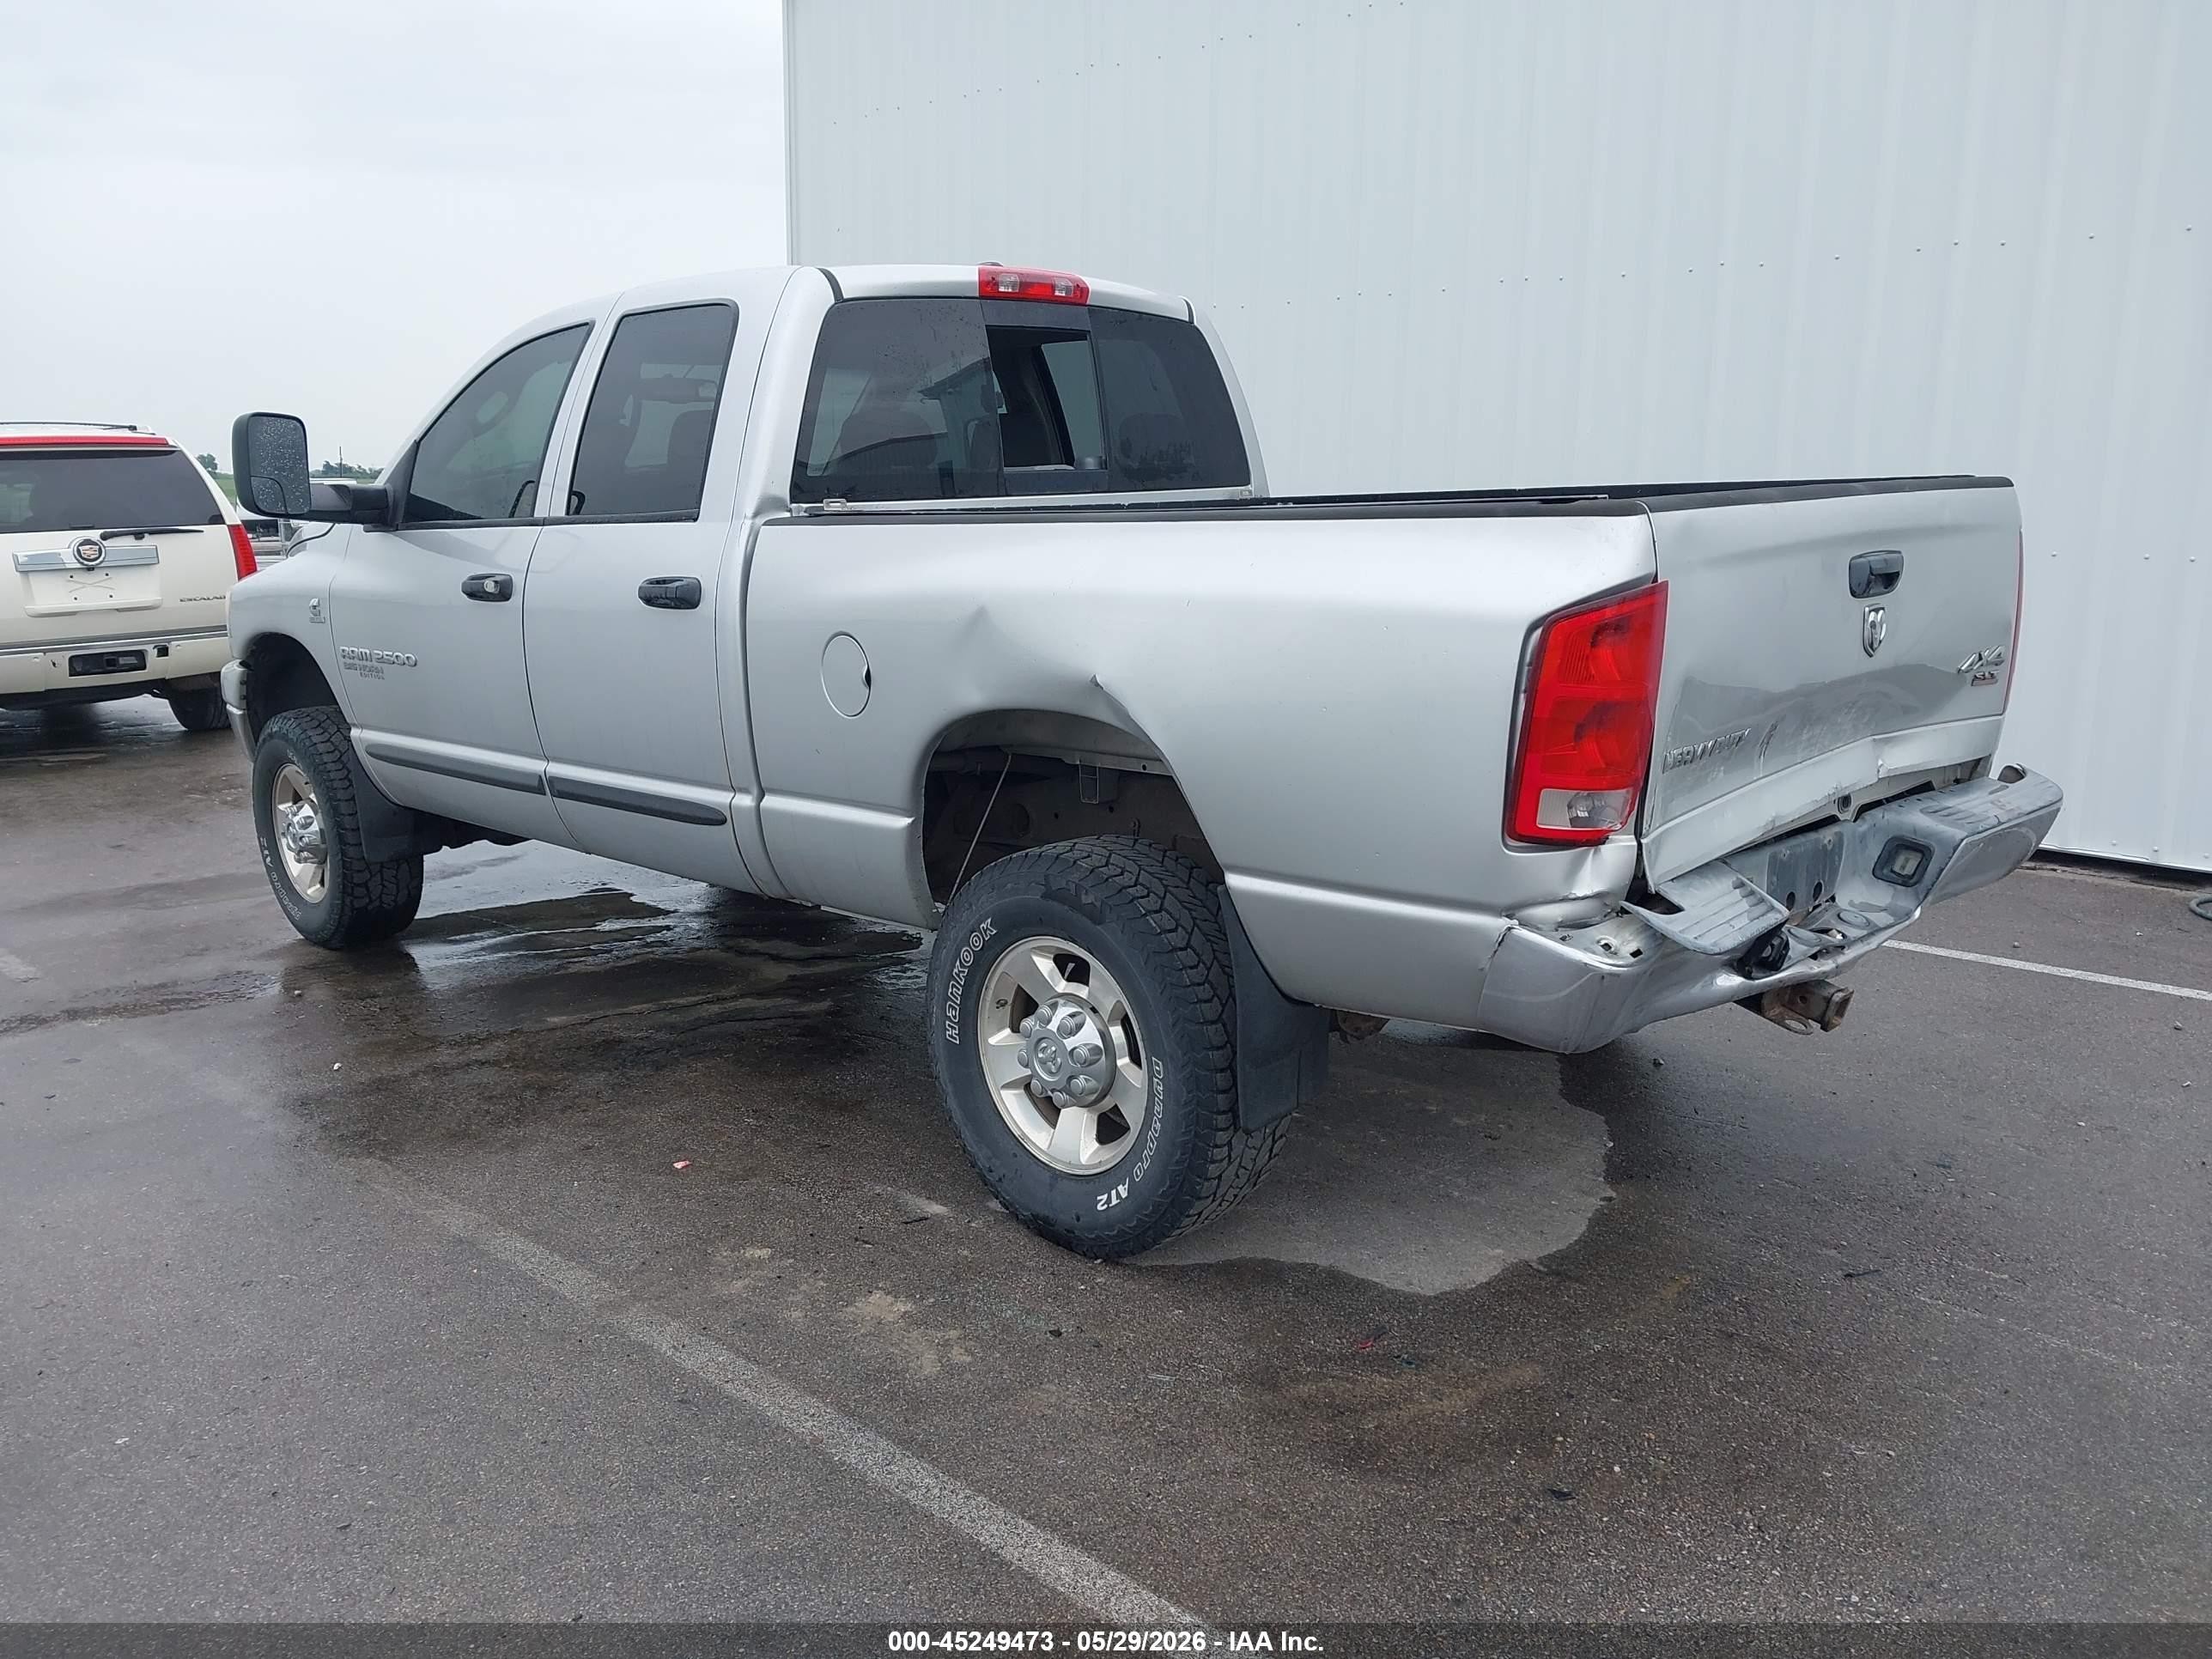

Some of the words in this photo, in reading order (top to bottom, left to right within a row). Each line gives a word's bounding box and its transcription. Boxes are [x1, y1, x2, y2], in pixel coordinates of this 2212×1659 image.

[339, 646, 372, 662] RAM
[373, 650, 418, 667] 2500
[1097, 1176, 1129, 1211] AT2
